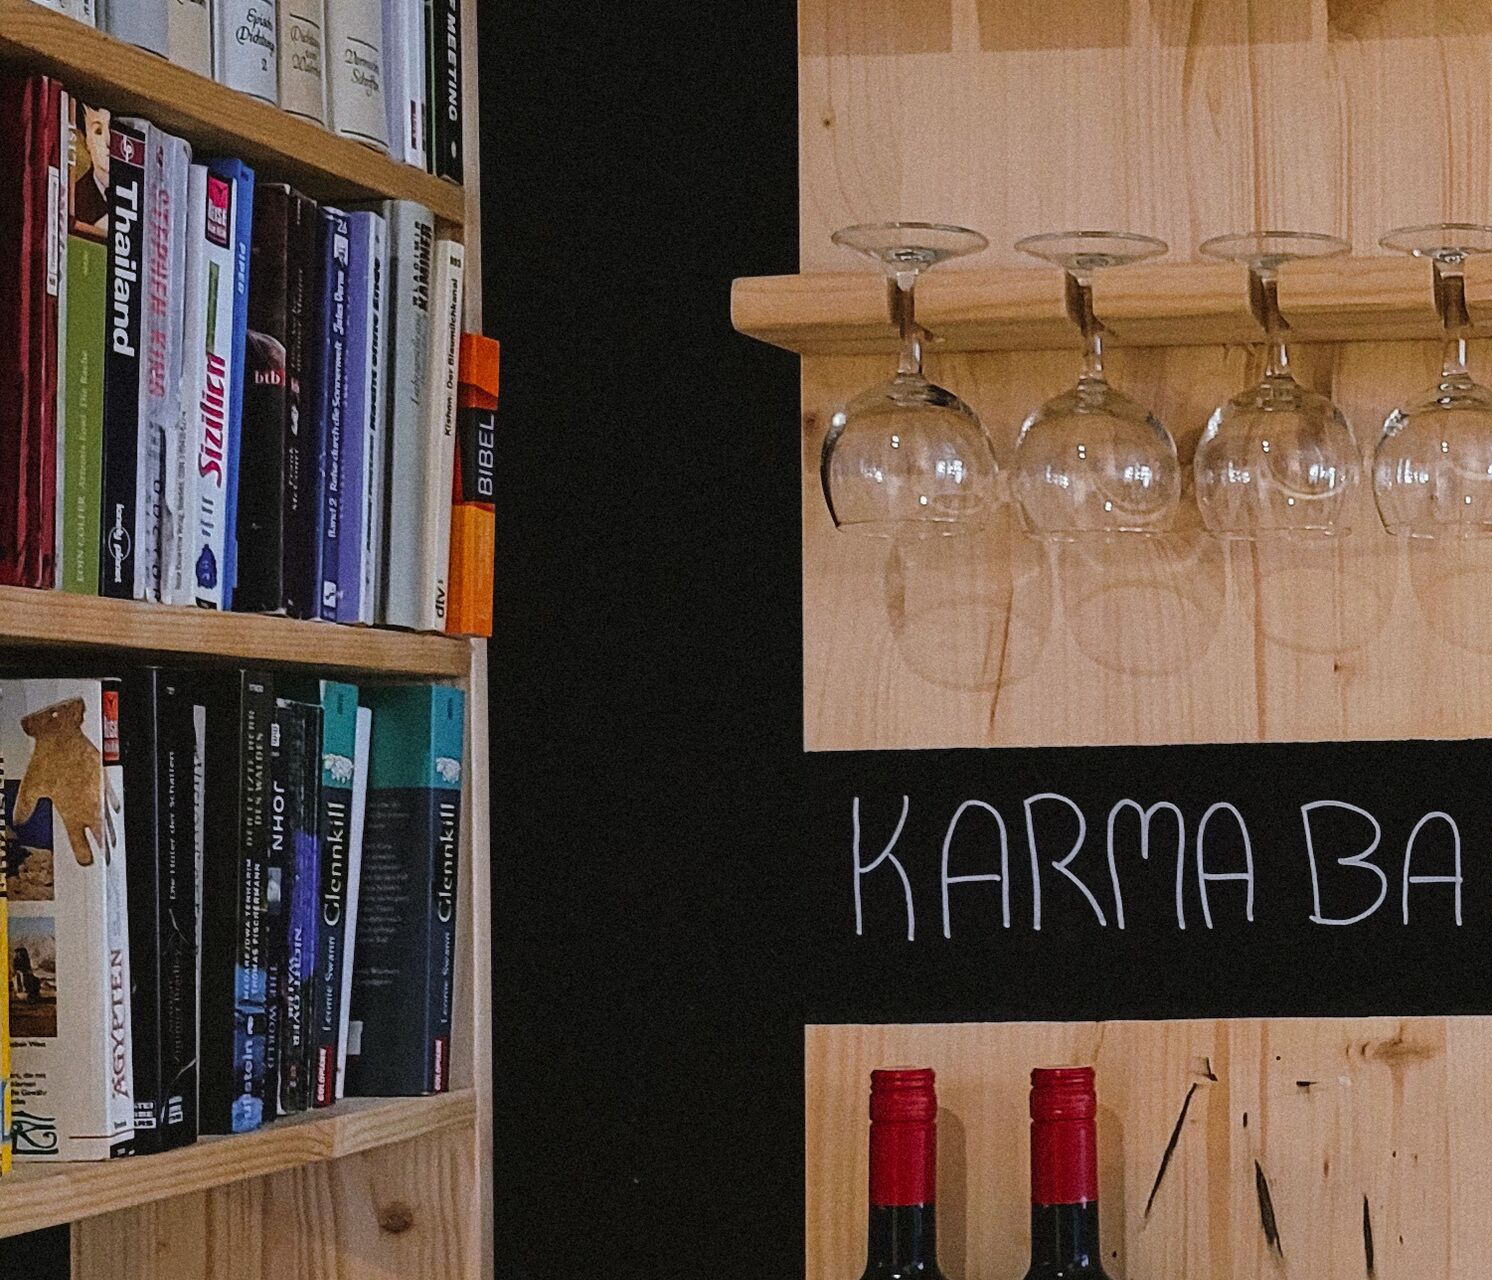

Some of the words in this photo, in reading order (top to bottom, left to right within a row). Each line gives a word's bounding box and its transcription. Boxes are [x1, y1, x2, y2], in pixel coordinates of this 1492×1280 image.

[447, 13, 458, 121] MEETING
[112, 180, 139, 357] Thailand
[418, 224, 431, 313] KAMINER
[448, 278, 458, 367] Blaumilchkanal
[254, 369, 282, 384] btb
[332, 341, 342, 407] Sonnenwelt
[199, 352, 226, 488] Sizilien
[478, 415, 495, 496] BIBEL
[434, 587, 446, 620] dtv
[272, 780, 285, 851] JOHN
[324, 802, 345, 926] Glennkill
[437, 803, 456, 922] Glennkill
[852, 792, 1255, 941] KARMA
[325, 936, 336, 981] Swann
[111, 950, 132, 1099] ÄGYPTEN
